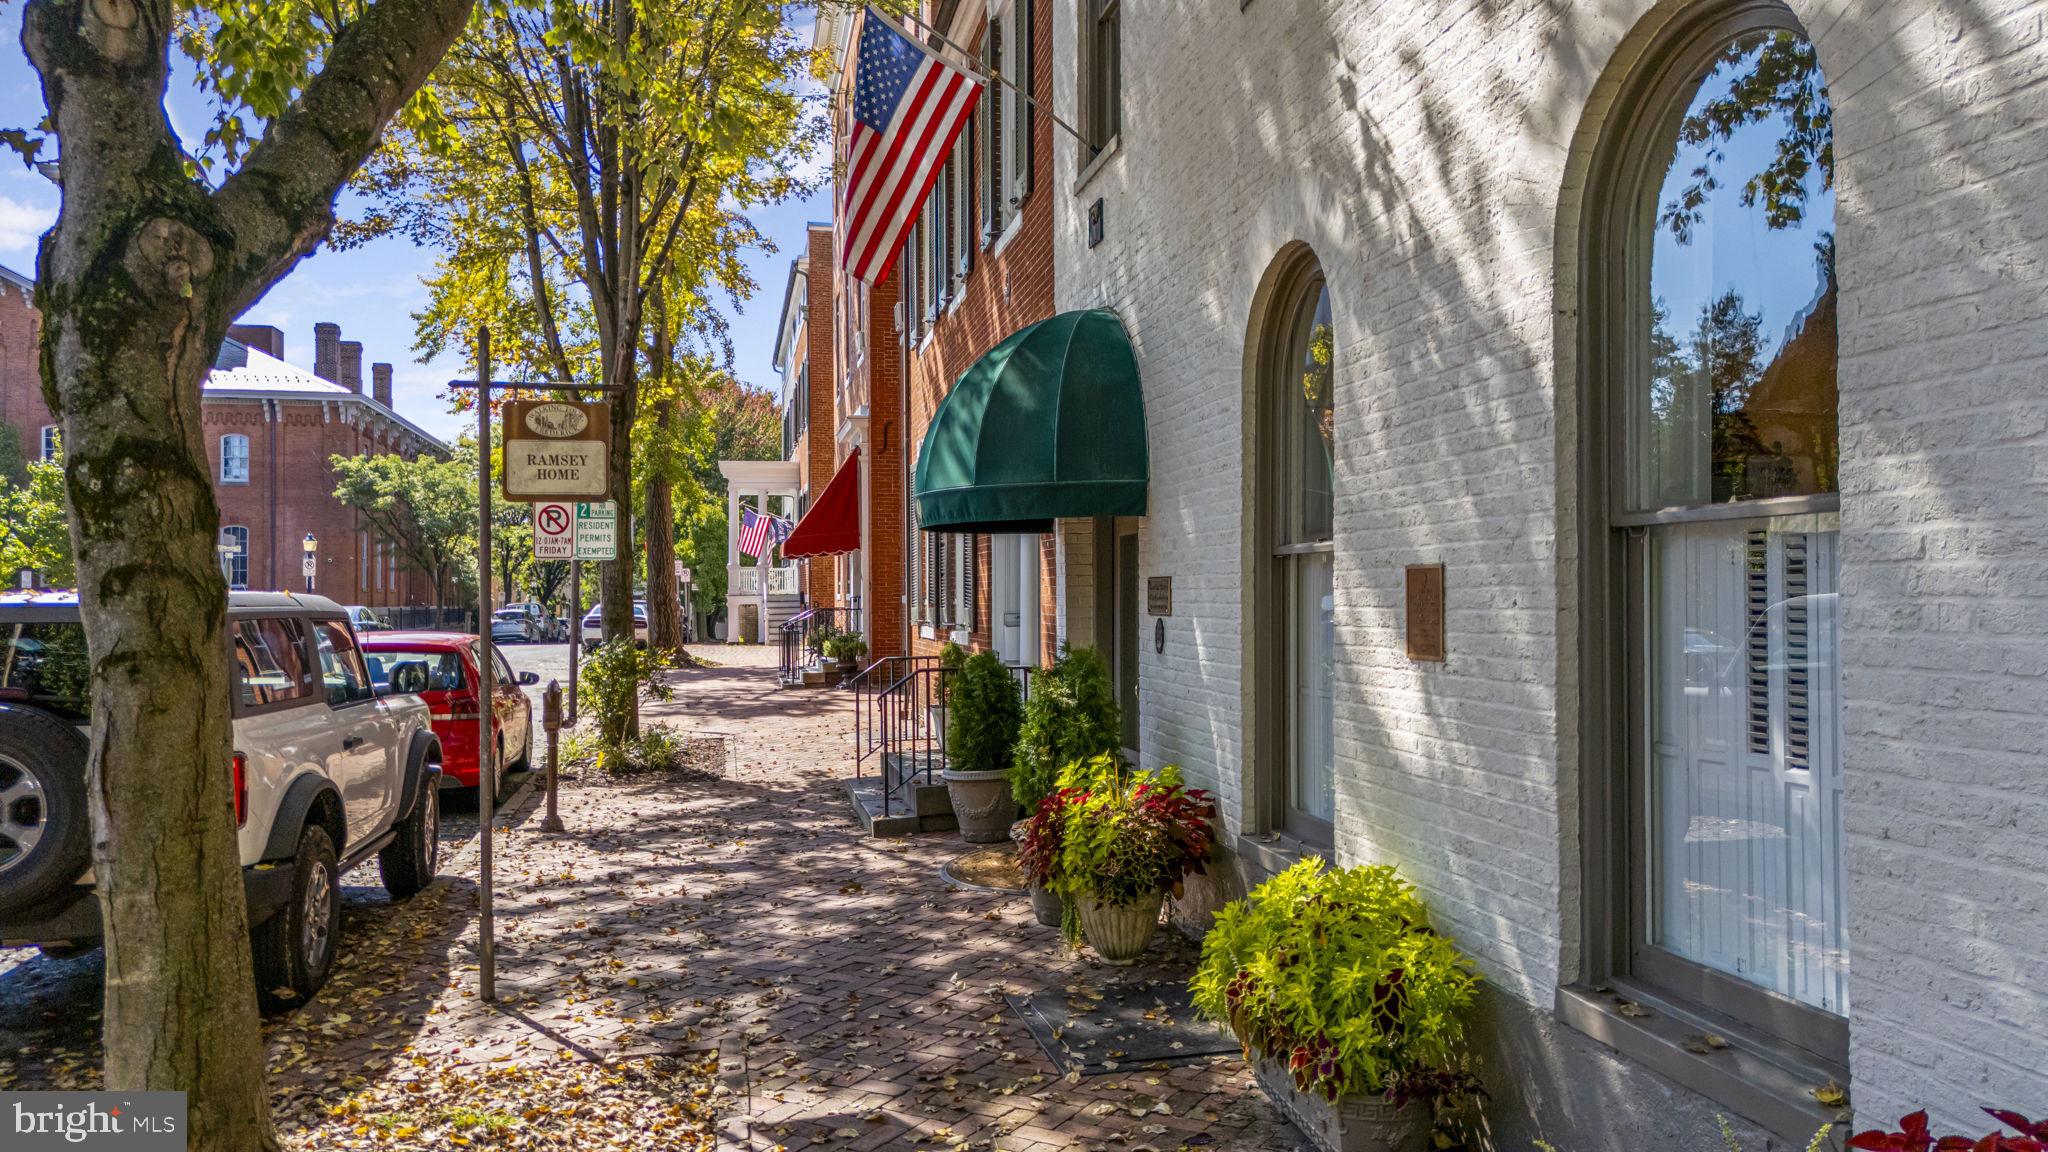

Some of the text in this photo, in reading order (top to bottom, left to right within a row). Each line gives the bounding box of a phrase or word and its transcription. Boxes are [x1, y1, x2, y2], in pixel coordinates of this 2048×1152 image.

[527, 454, 588, 466] RAMSEY
[537, 468, 580, 480] HOME
[581, 503, 587, 517] 2
[592, 509, 614, 517] PARKING
[578, 521, 614, 530] RESIDENT
[580, 534, 611, 542] PERMITS
[539, 546, 567, 554] FRIDAY
[578, 546, 614, 555] EXEMPTED
